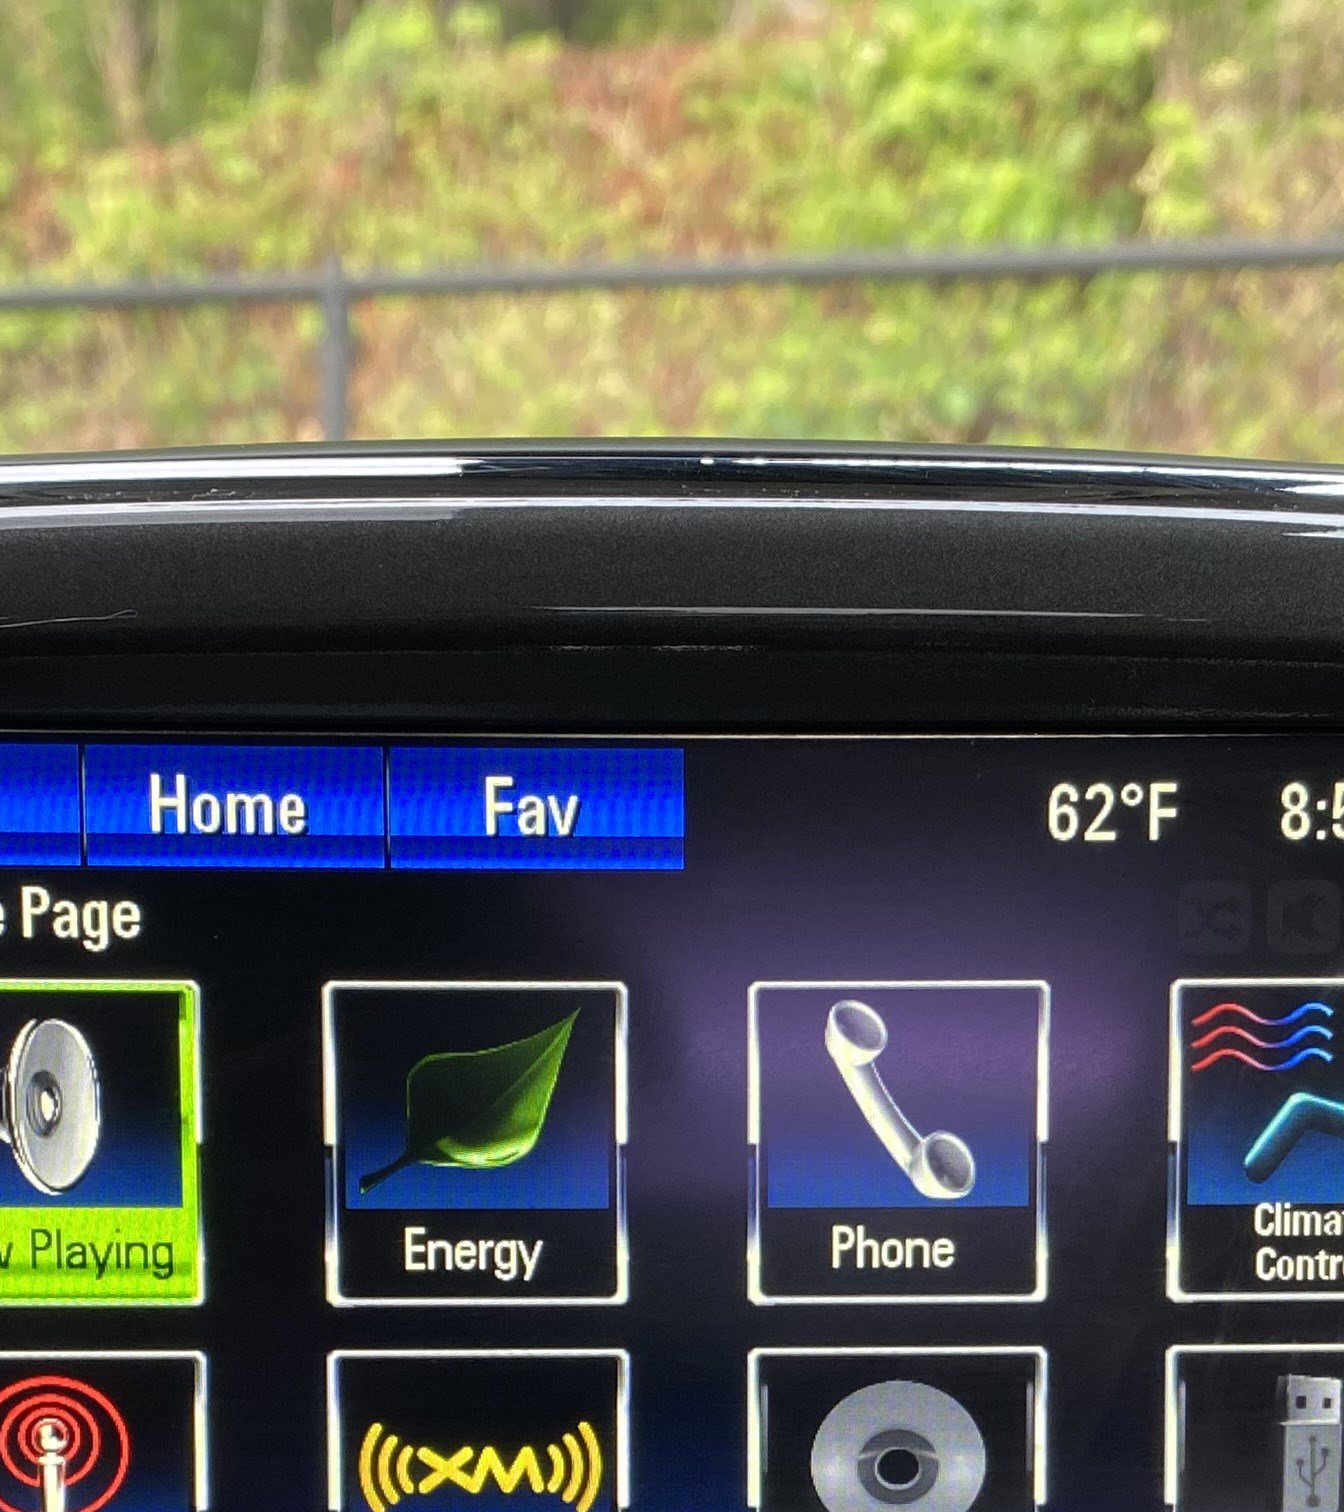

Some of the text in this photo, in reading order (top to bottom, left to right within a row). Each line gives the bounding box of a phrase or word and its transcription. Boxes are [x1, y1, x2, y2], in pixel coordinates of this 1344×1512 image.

[148, 773, 307, 836] Home
[484, 775, 580, 837] Fav
[1047, 781, 1179, 843] 62°F
[20, 884, 142, 953] Page
[29, 1228, 176, 1280] Playing
[403, 1225, 545, 1283] Energy
[831, 1223, 956, 1270] Phone
